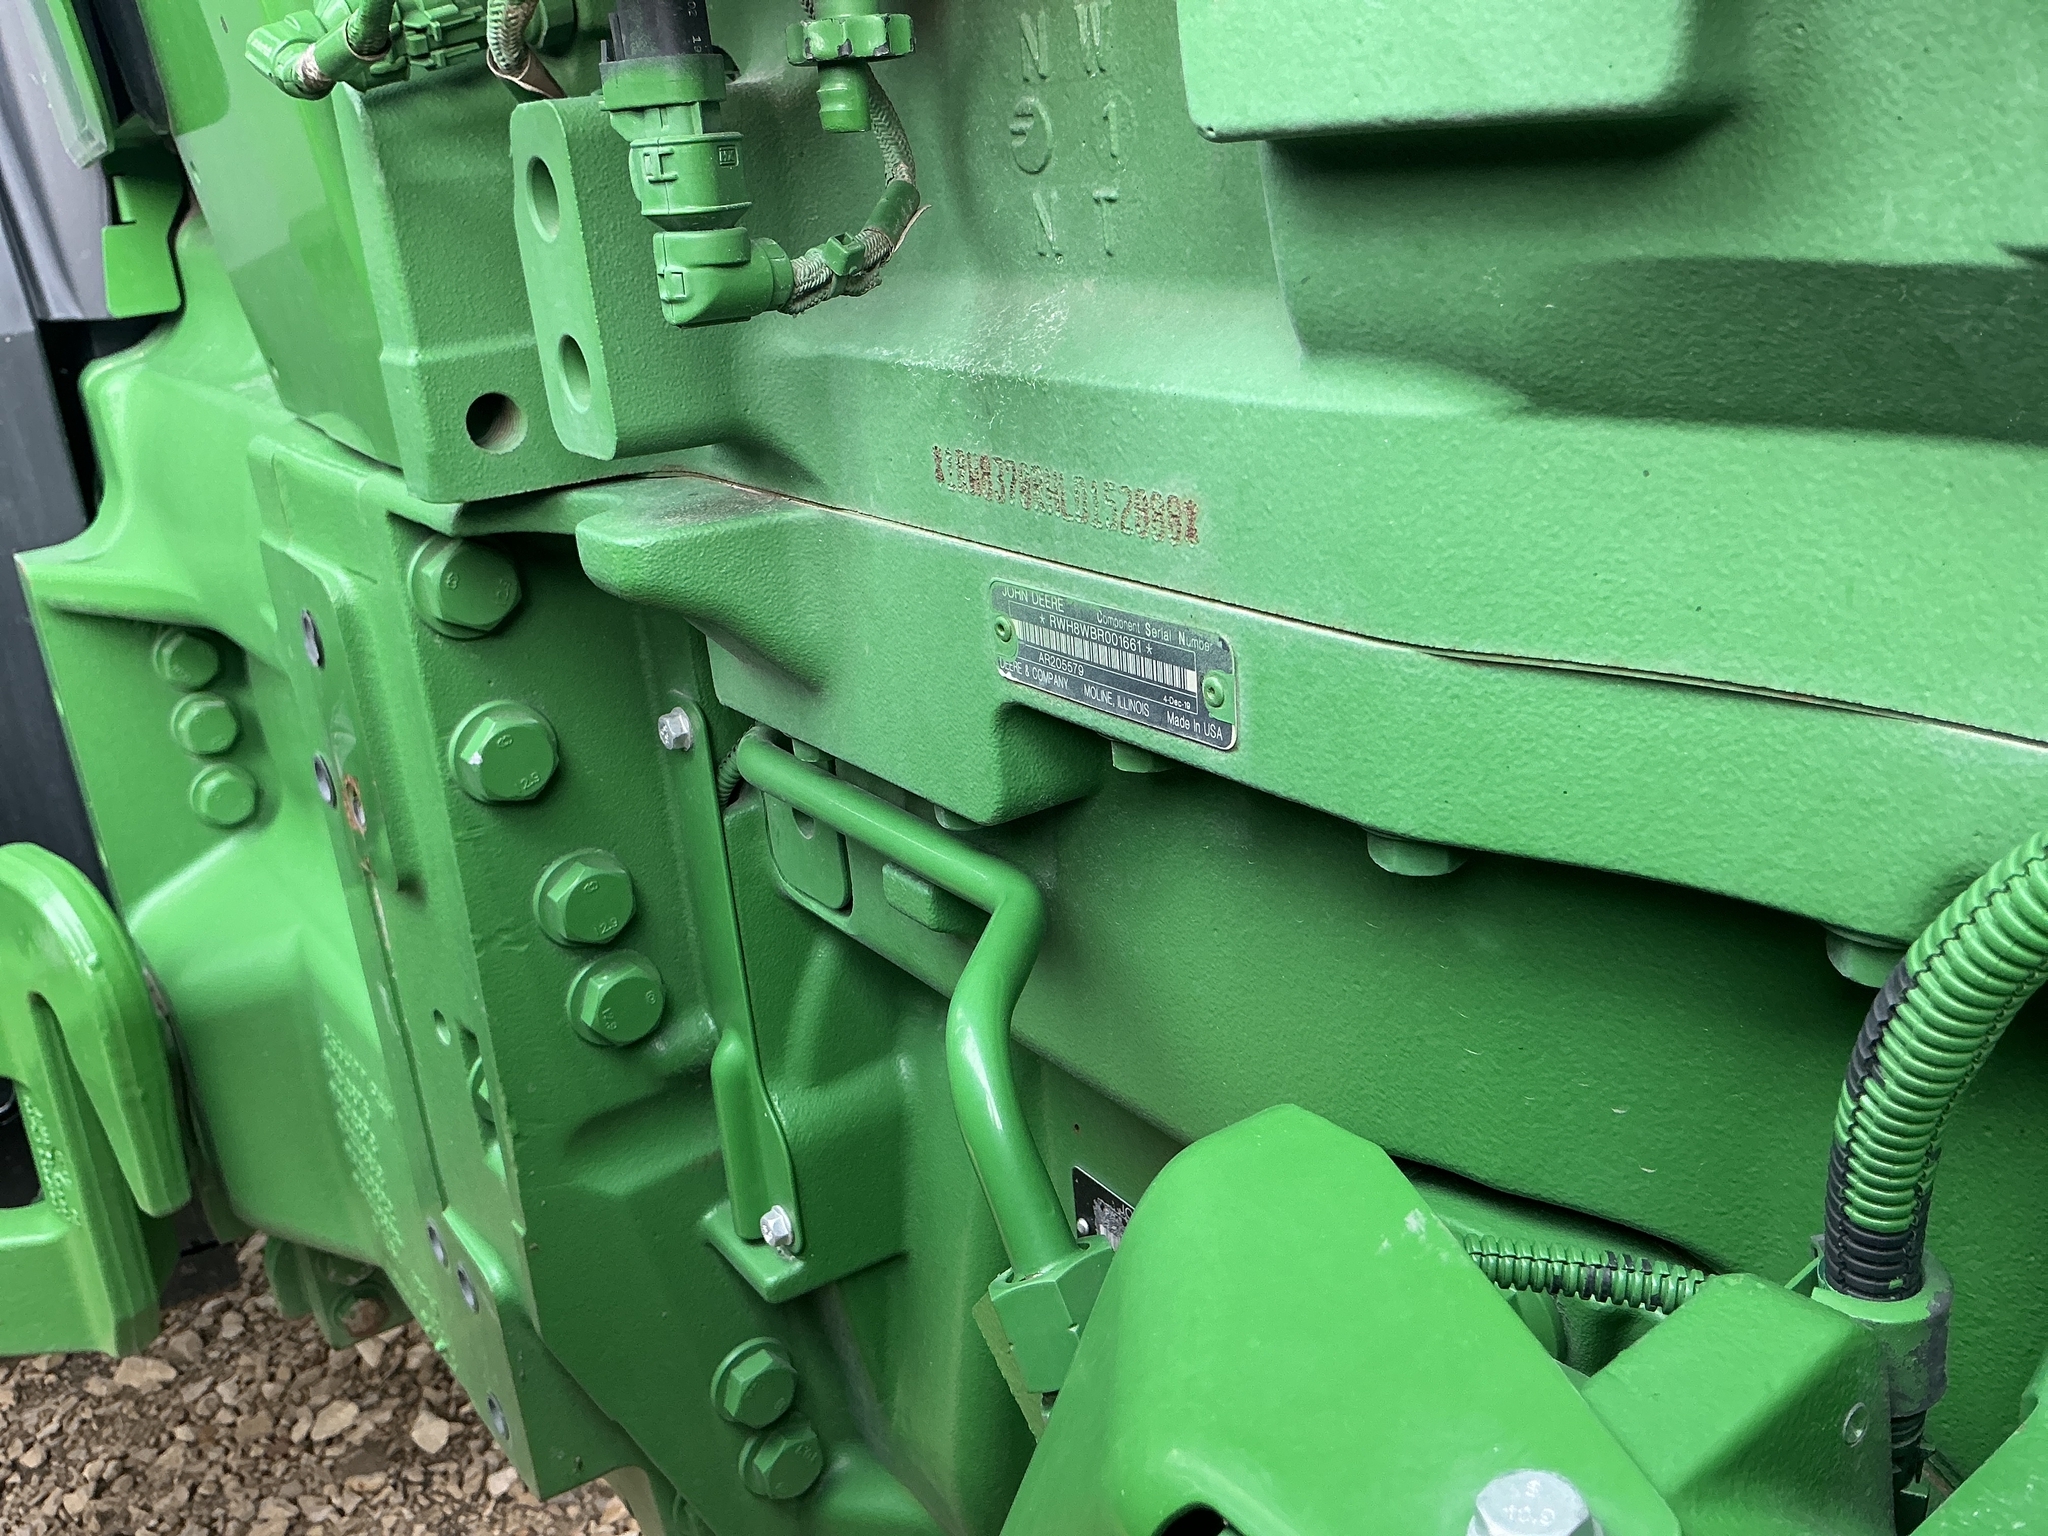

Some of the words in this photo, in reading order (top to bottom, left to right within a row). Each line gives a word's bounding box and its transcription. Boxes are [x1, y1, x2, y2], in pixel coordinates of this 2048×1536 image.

[1001, 586, 1029, 603] JOHN
[1031, 591, 1065, 613] DEERE
[1049, 614, 1142, 653] RWH8WBR001661
[1096, 609, 1141, 634] Component
[1144, 621, 1172, 642] Serial
[1178, 630, 1213, 652] Number
[1038, 651, 1085, 677] AR205579
[1032, 666, 1069, 689] COMPANY
[1116, 694, 1150, 718] ILLINOIS
[1166, 710, 1190, 729] Made
[1203, 722, 1223, 741] USA
[1162, 694, 1191, 710] 4-Dec-19
